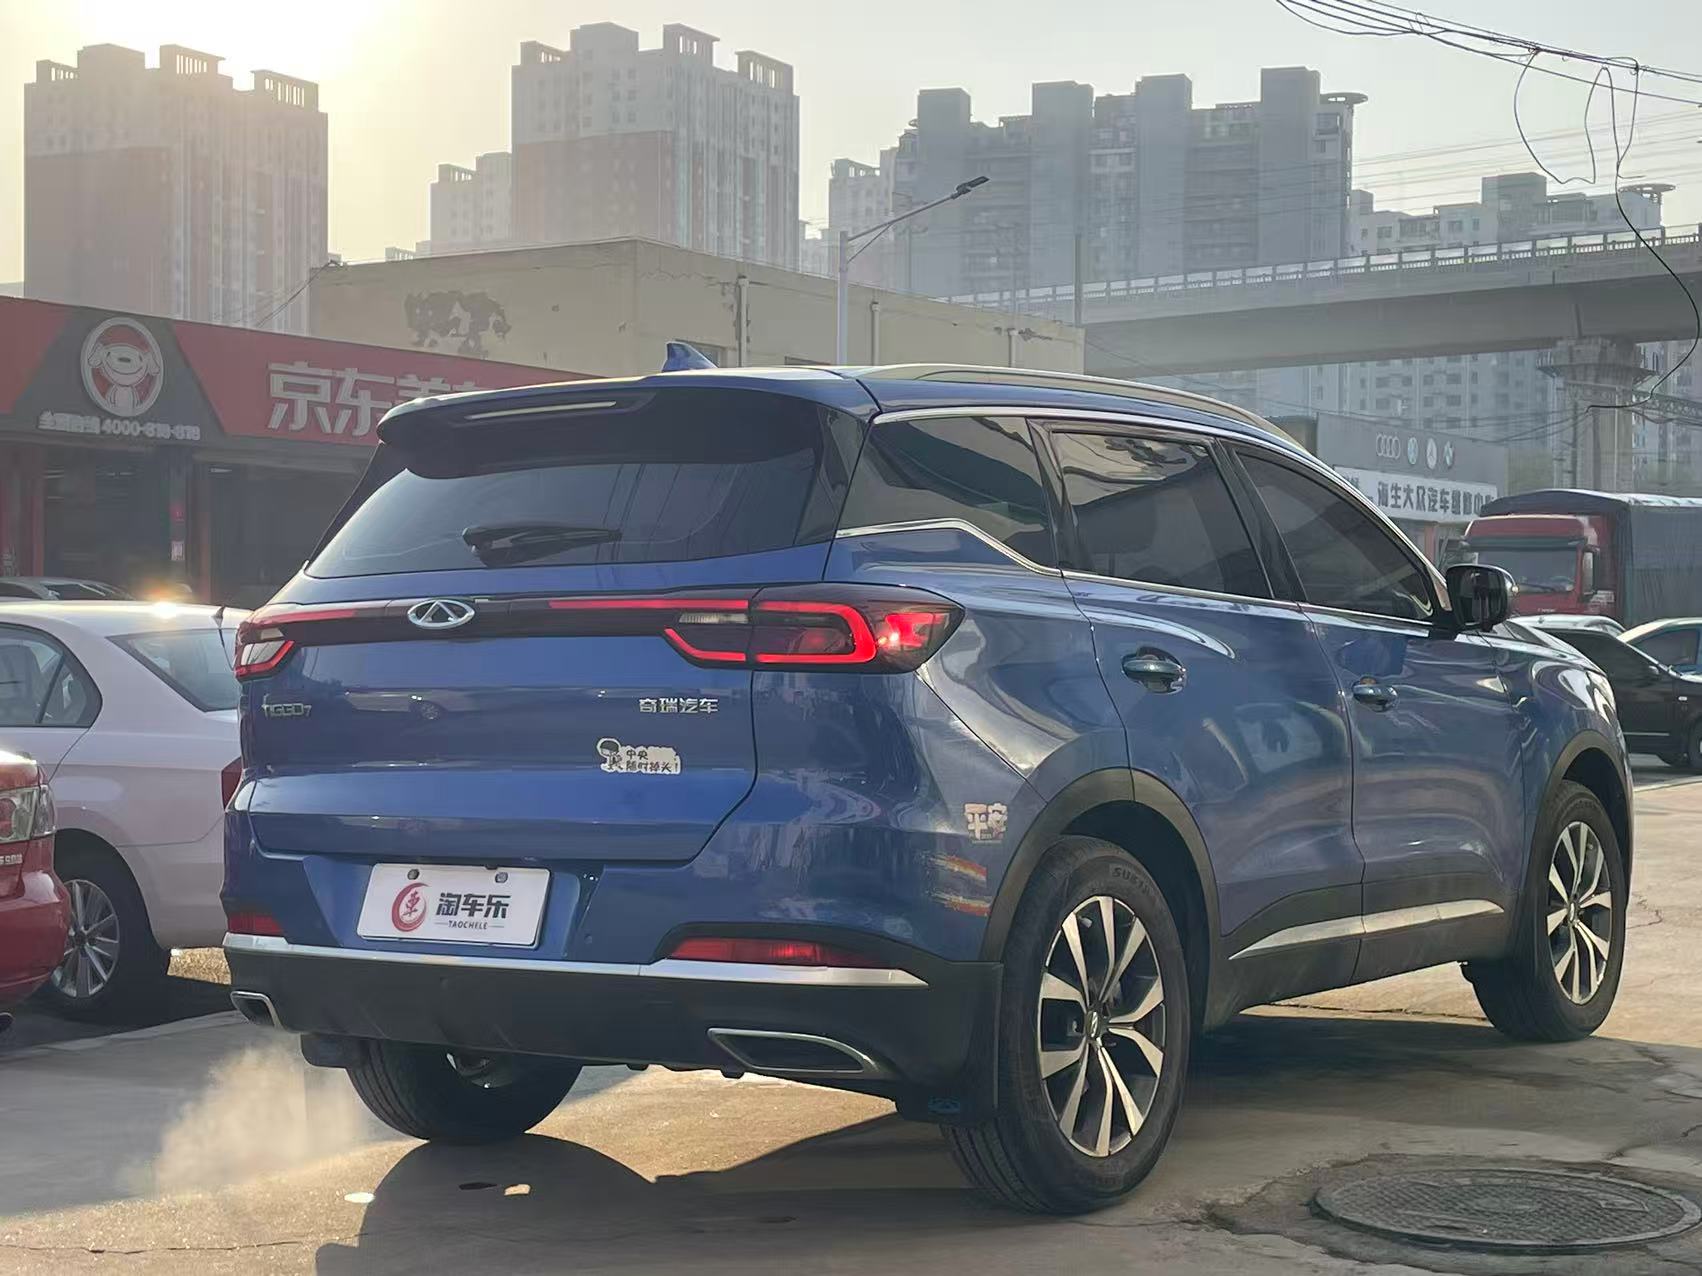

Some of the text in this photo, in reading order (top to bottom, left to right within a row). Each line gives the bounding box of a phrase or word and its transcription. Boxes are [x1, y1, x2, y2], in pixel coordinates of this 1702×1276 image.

[638, 697, 719, 714] 奇瑞汽车
[436, 892, 511, 919] 淘车乐
[448, 920, 488, 930] TAOCHELE
